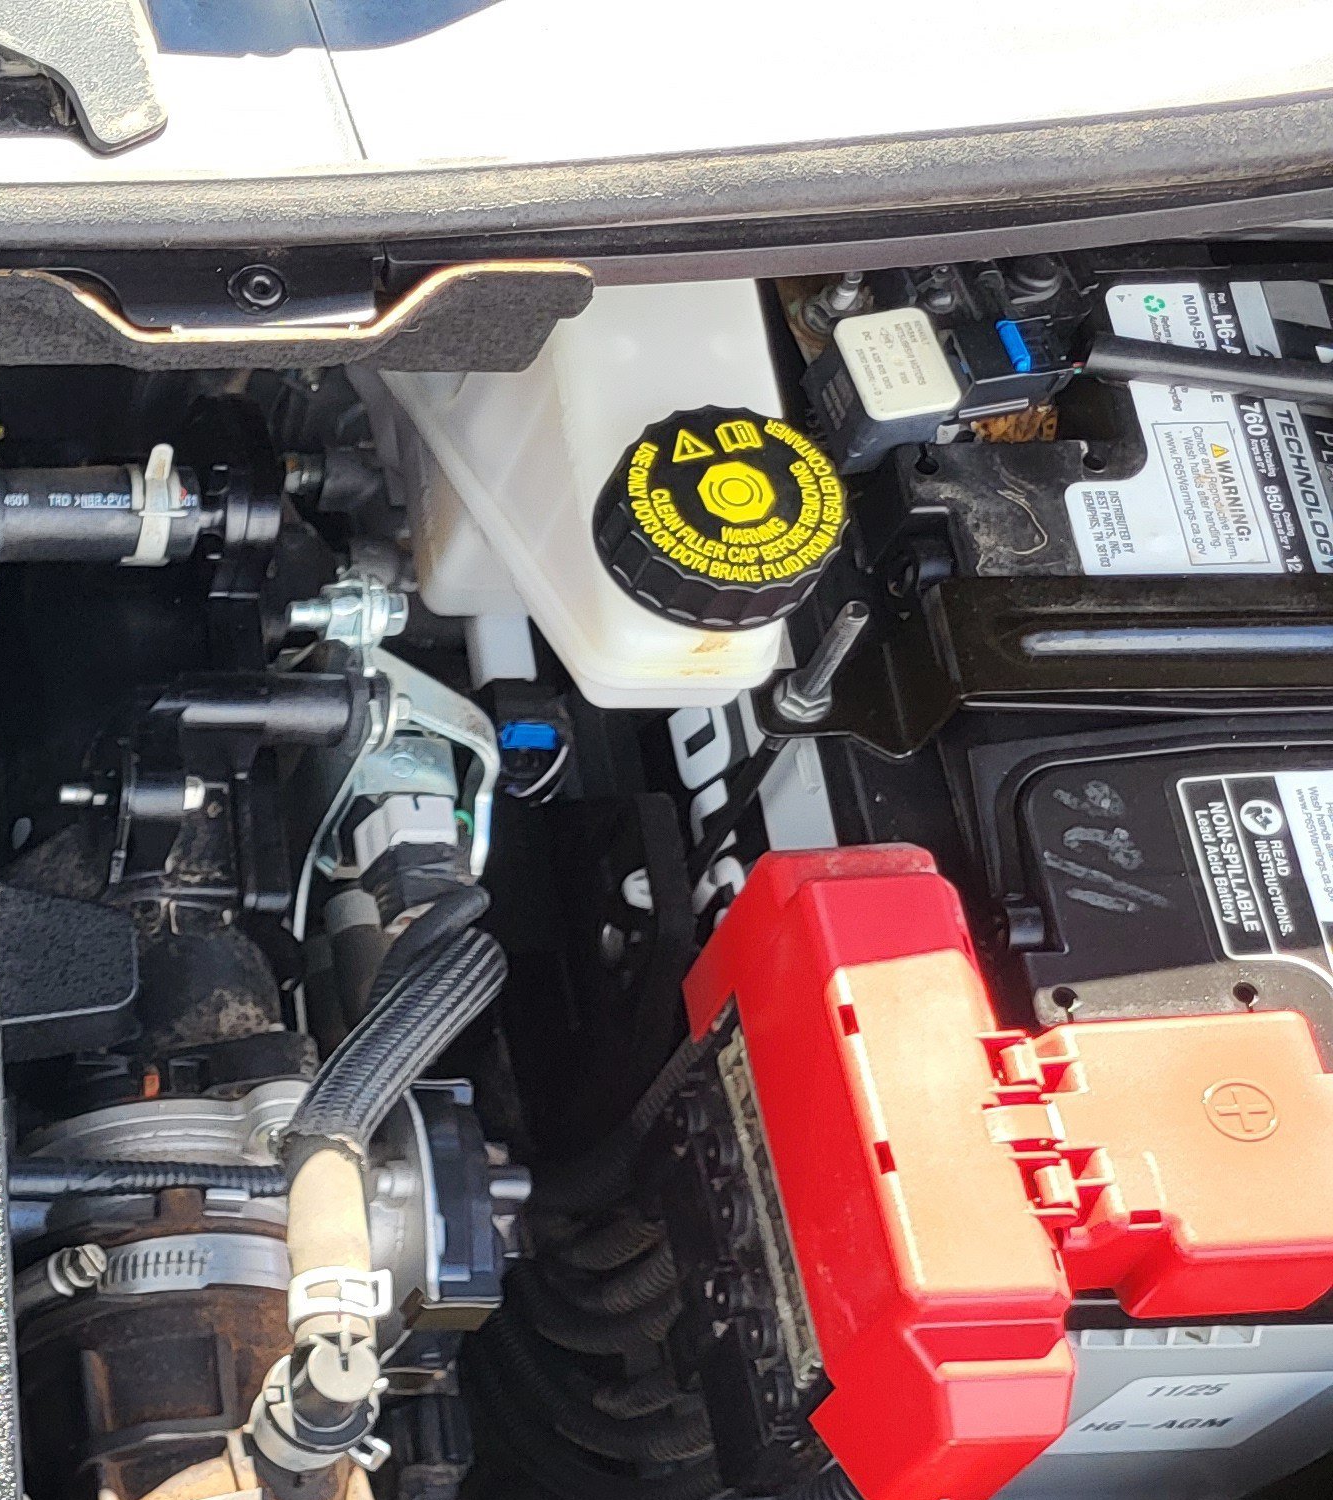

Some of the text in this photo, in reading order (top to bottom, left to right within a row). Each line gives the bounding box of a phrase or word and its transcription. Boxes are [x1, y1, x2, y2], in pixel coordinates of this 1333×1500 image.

[628, 419, 843, 582] USE ONLY DOT3 OR DOT4 BRAKE FLUID FROM A SEALED CONTAINER
[1095, 491, 1109, 510] BEST
[1162, 433, 1208, 554] www.P65Warnings.ca.gov
[1182, 437, 1222, 547] Wash hands after handling.
[1192, 427, 1239, 556] Cancer and Reproductive Harm.
[1215, 462, 1252, 539] WARNING:
[1239, 404, 1267, 434] 760
[1263, 486, 1284, 509] 950
[1278, 411, 1333, 568] TECHNOLOGY
[651, 460, 821, 563] CLEAN FILLER CAP BEFORE REMOVING
[721, 517, 788, 545] WARNING
[1079, 492, 1100, 526] MEMPHIS,
[1092, 532, 1104, 540] TN
[1099, 513, 1116, 536] PARTS,
[1107, 491, 1134, 552] DISTRIBUTED BY
[1268, 840, 1291, 875] READ
[1306, 788, 1323, 810] Wash
[1315, 814, 1332, 838] hands
[1194, 810, 1239, 923] Lead Acid Battery
[1207, 802, 1260, 930] NON-SPILLABLE
[1254, 840, 1293, 934] INSTRUCTIONS.
[1146, 1383, 1230, 1398] 11/25
